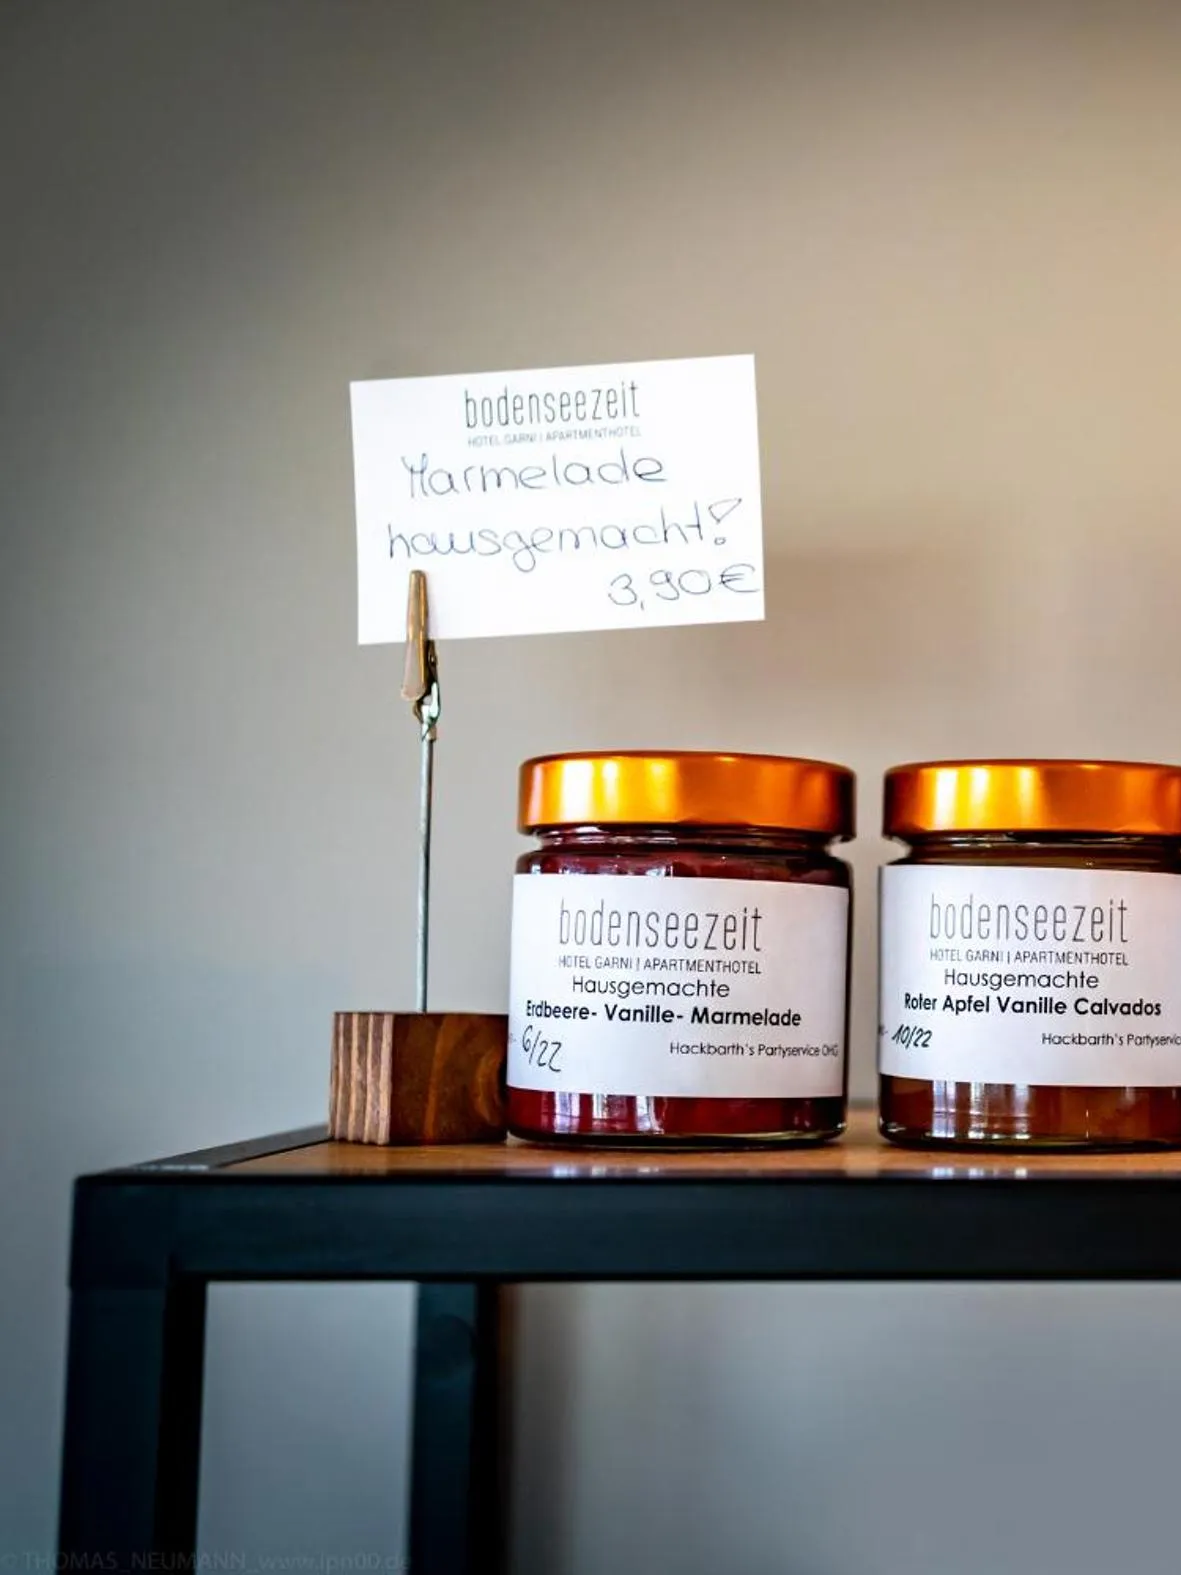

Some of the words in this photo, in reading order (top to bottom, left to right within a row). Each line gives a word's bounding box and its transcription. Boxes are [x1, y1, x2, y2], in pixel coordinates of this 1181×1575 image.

[465, 380, 640, 429] bodenseezeit
[468, 433, 499, 448] HOTEL
[504, 430, 536, 445] GARNI
[545, 425, 642, 442] APARTMENTHOTEL
[401, 448, 668, 499] Marmelade
[387, 498, 743, 573] hausgemacht!
[607, 563, 760, 611] 3,90€
[560, 898, 762, 951] bodenseezeit
[930, 893, 1128, 943] bodenseezeit
[559, 955, 592, 969] HOTEL
[595, 956, 633, 970] GARNI
[643, 958, 762, 975] APARTMENTHOTEL
[930, 949, 962, 962] HOTEL
[965, 950, 1004, 963] GARNI
[1014, 951, 1129, 966] APARTMENTHOTEL
[572, 976, 730, 999] Hausgemachte
[944, 968, 1100, 991] Hausgemachte
[526, 1000, 598, 1021] Erdbeere-
[604, 1003, 684, 1024] Vanille-
[690, 1006, 801, 1027] Marmelade
[904, 993, 937, 1011] Roter
[942, 994, 990, 1017] Apfel
[996, 996, 1067, 1015] Vanille
[1074, 997, 1162, 1016] Calvados
[521, 1025, 562, 1073] 6/22
[670, 1041, 755, 1056] Hackbarth's
[891, 1024, 933, 1050] 10/22
[1041, 1032, 1124, 1047] Hackbarth's
